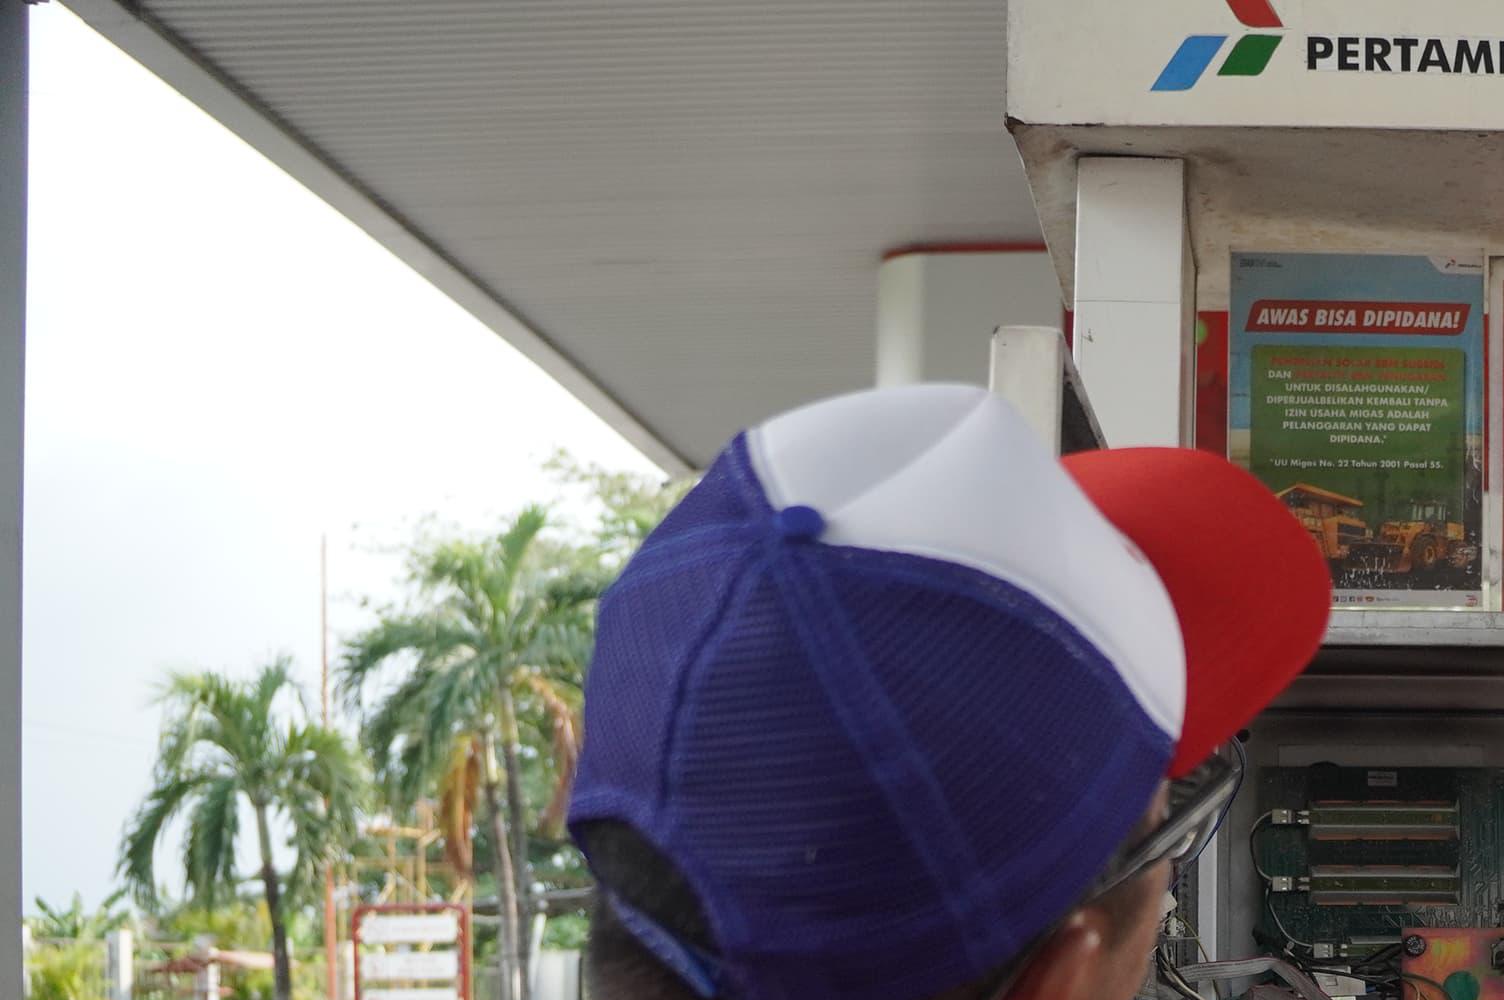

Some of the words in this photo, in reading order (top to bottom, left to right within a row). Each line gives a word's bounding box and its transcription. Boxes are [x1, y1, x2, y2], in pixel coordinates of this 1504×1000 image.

[1257, 308, 1308, 326] AWAS
[1315, 309, 1357, 327] BISA
[1364, 310, 1460, 328] DIPIDANA!
[1268, 370, 1292, 379] DAN
[1285, 383, 1321, 392] UNTUK
[1325, 383, 1430, 394] DISALAHGUNAKAN/
[1266, 395, 1364, 405] DIPERJUALBELIKAN
[1367, 396, 1411, 406] KEMBALI
[1414, 398, 1449, 407] TANPA
[1284, 409, 1307, 417] IZIN
[1310, 409, 1346, 418] USAHA
[1349, 410, 1384, 418] MIGAS
[1387, 410, 1429, 419] ADALAH
[1282, 421, 1362, 430] PELANGGARAN
[1365, 422, 1395, 431] YANG
[1398, 423, 1432, 432] DAPAT
[1290, 459, 1317, 468] Migas
[1352, 459, 1378, 467] Tahun
[1381, 460, 1401, 468] 2001
[1403, 460, 1427, 468] Pasal
